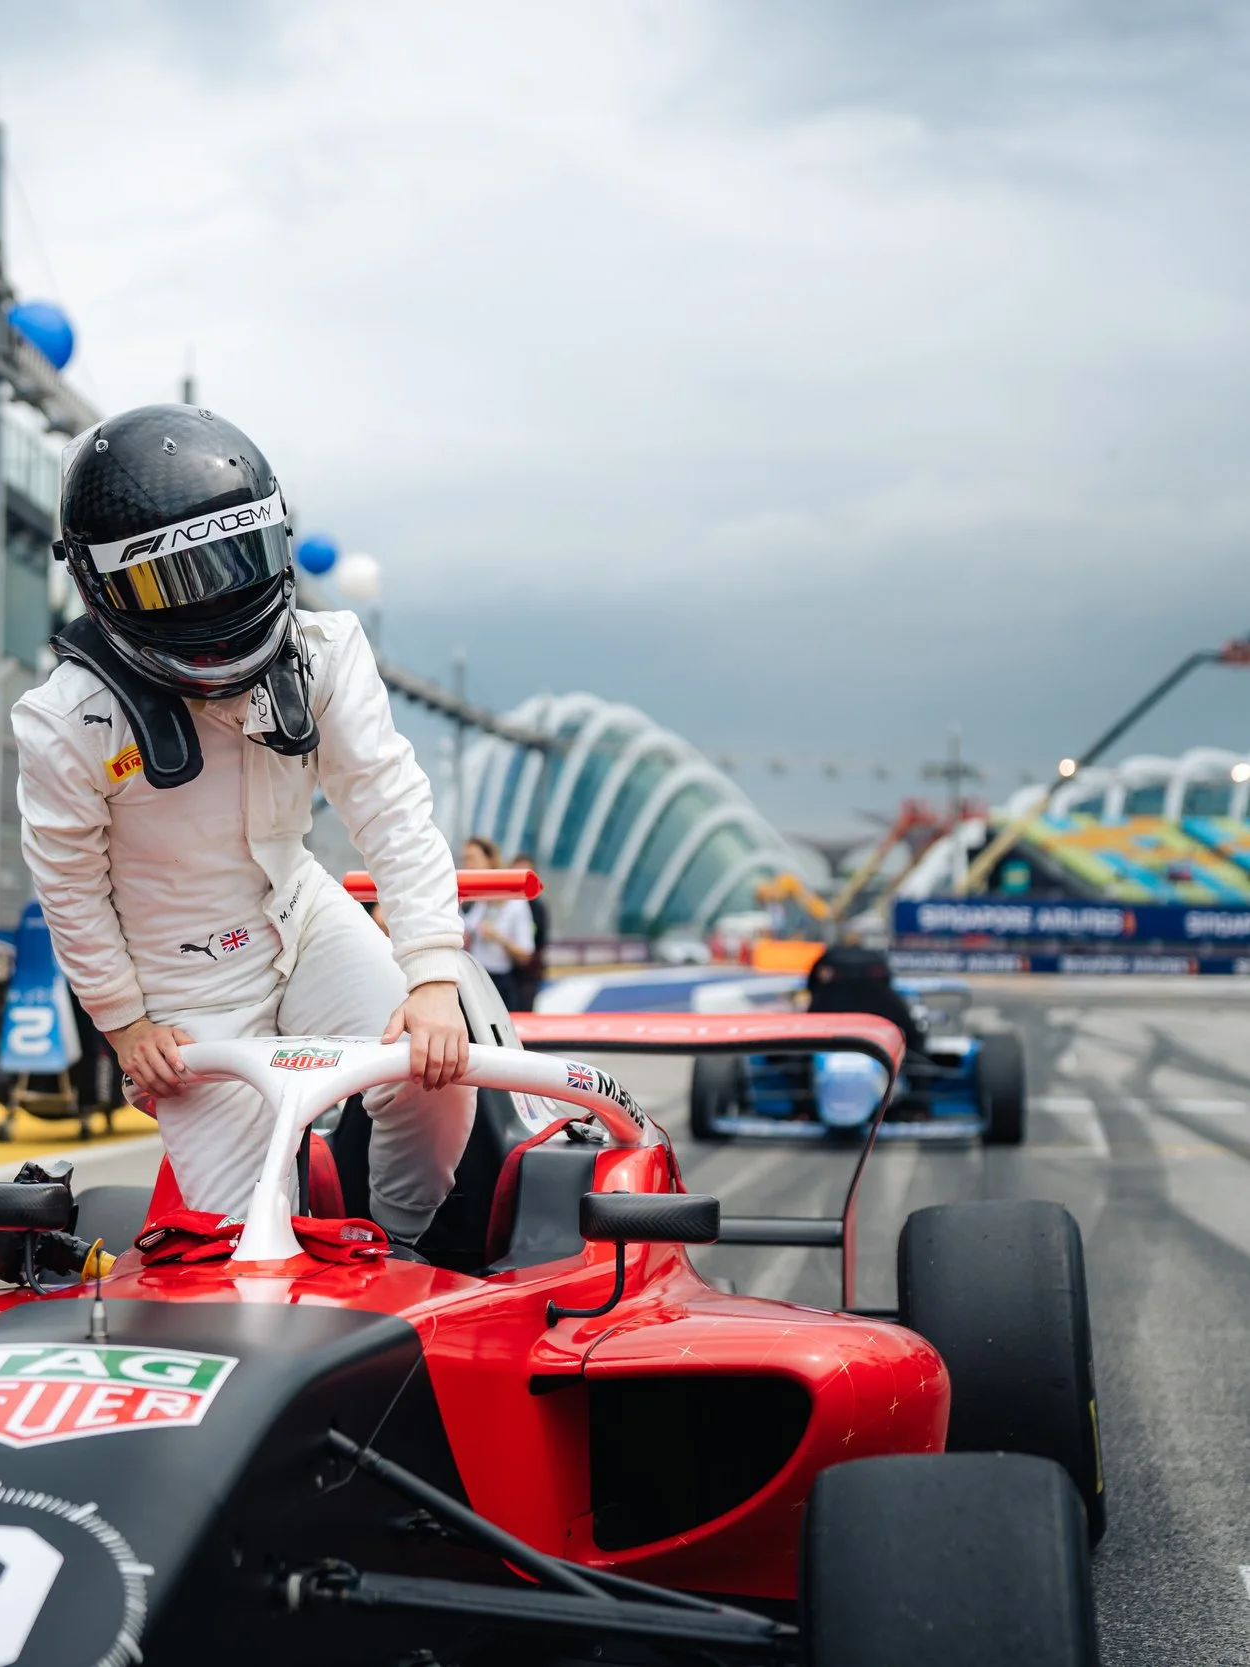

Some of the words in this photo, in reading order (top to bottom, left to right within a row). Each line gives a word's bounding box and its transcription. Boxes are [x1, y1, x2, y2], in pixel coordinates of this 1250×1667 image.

[171, 503, 271, 548] ACADEMY
[7, 1005, 54, 1055] 2
[275, 1056, 335, 1069] HEUER
[282, 1047, 335, 1058] TAG
